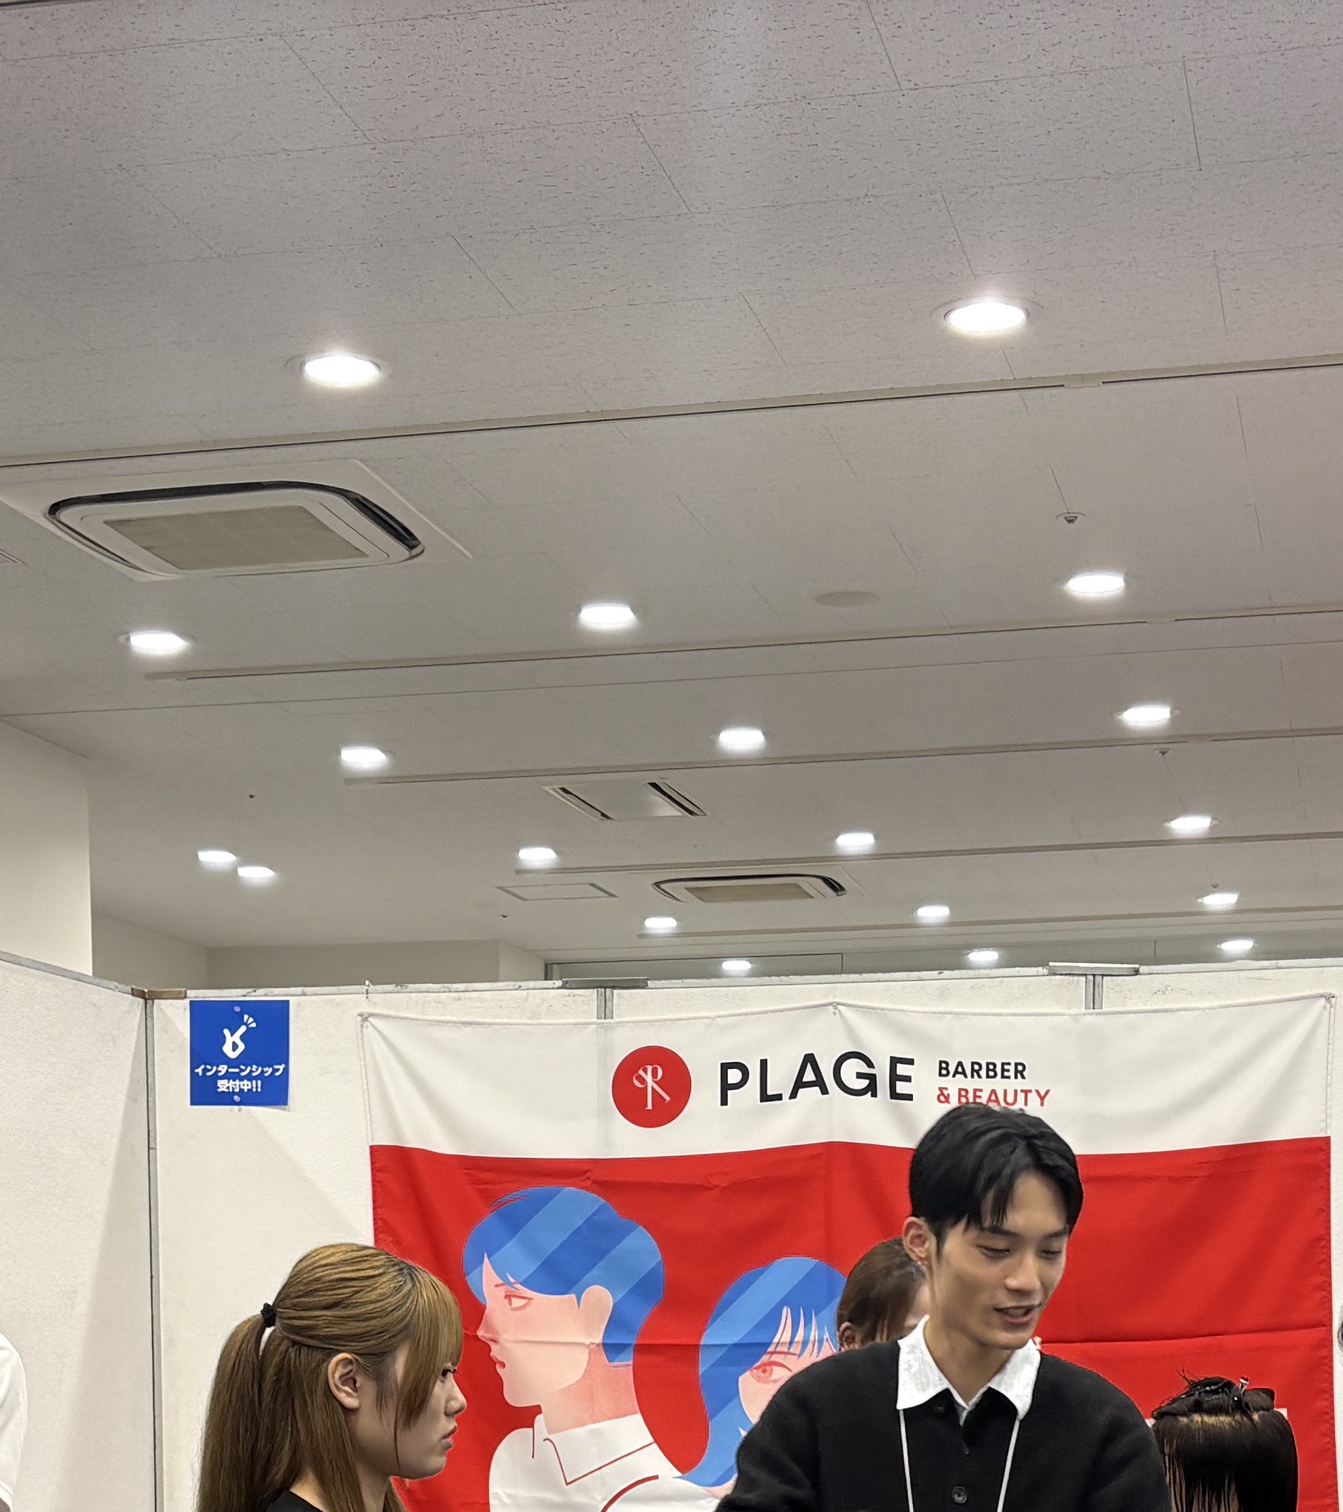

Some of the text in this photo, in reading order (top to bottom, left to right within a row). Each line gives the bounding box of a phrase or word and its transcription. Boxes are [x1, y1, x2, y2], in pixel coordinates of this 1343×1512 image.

[194, 1063, 286, 1078] インターンシップ
[719, 1050, 916, 1107] PLAGE
[938, 1059, 1027, 1080] BARBER
[216, 1079, 262, 1093] 受付中!!
[936, 1086, 1052, 1107] & BEAUTY
